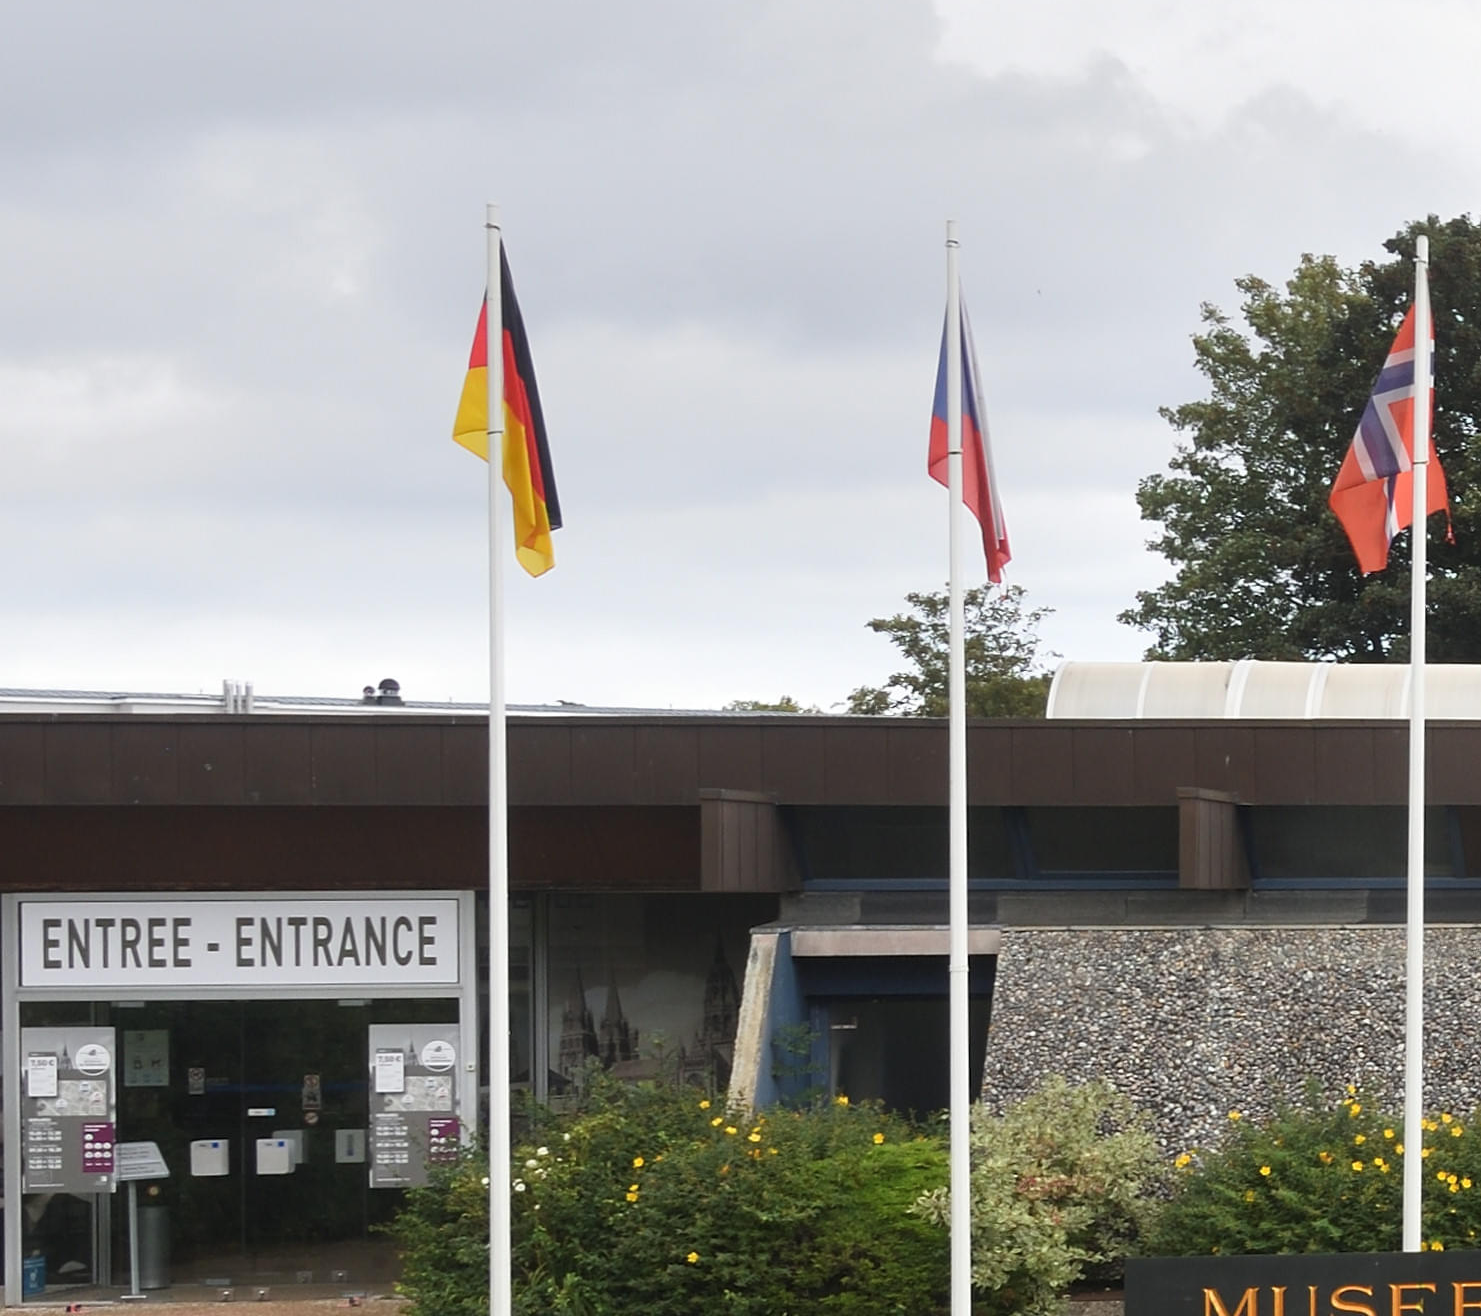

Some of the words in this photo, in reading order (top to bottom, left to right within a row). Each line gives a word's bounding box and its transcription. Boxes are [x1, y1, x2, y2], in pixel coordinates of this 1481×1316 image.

[42, 917, 192, 969] ENTREE
[207, 942, 220, 952] -
[235, 915, 437, 967] ENTRANCE
